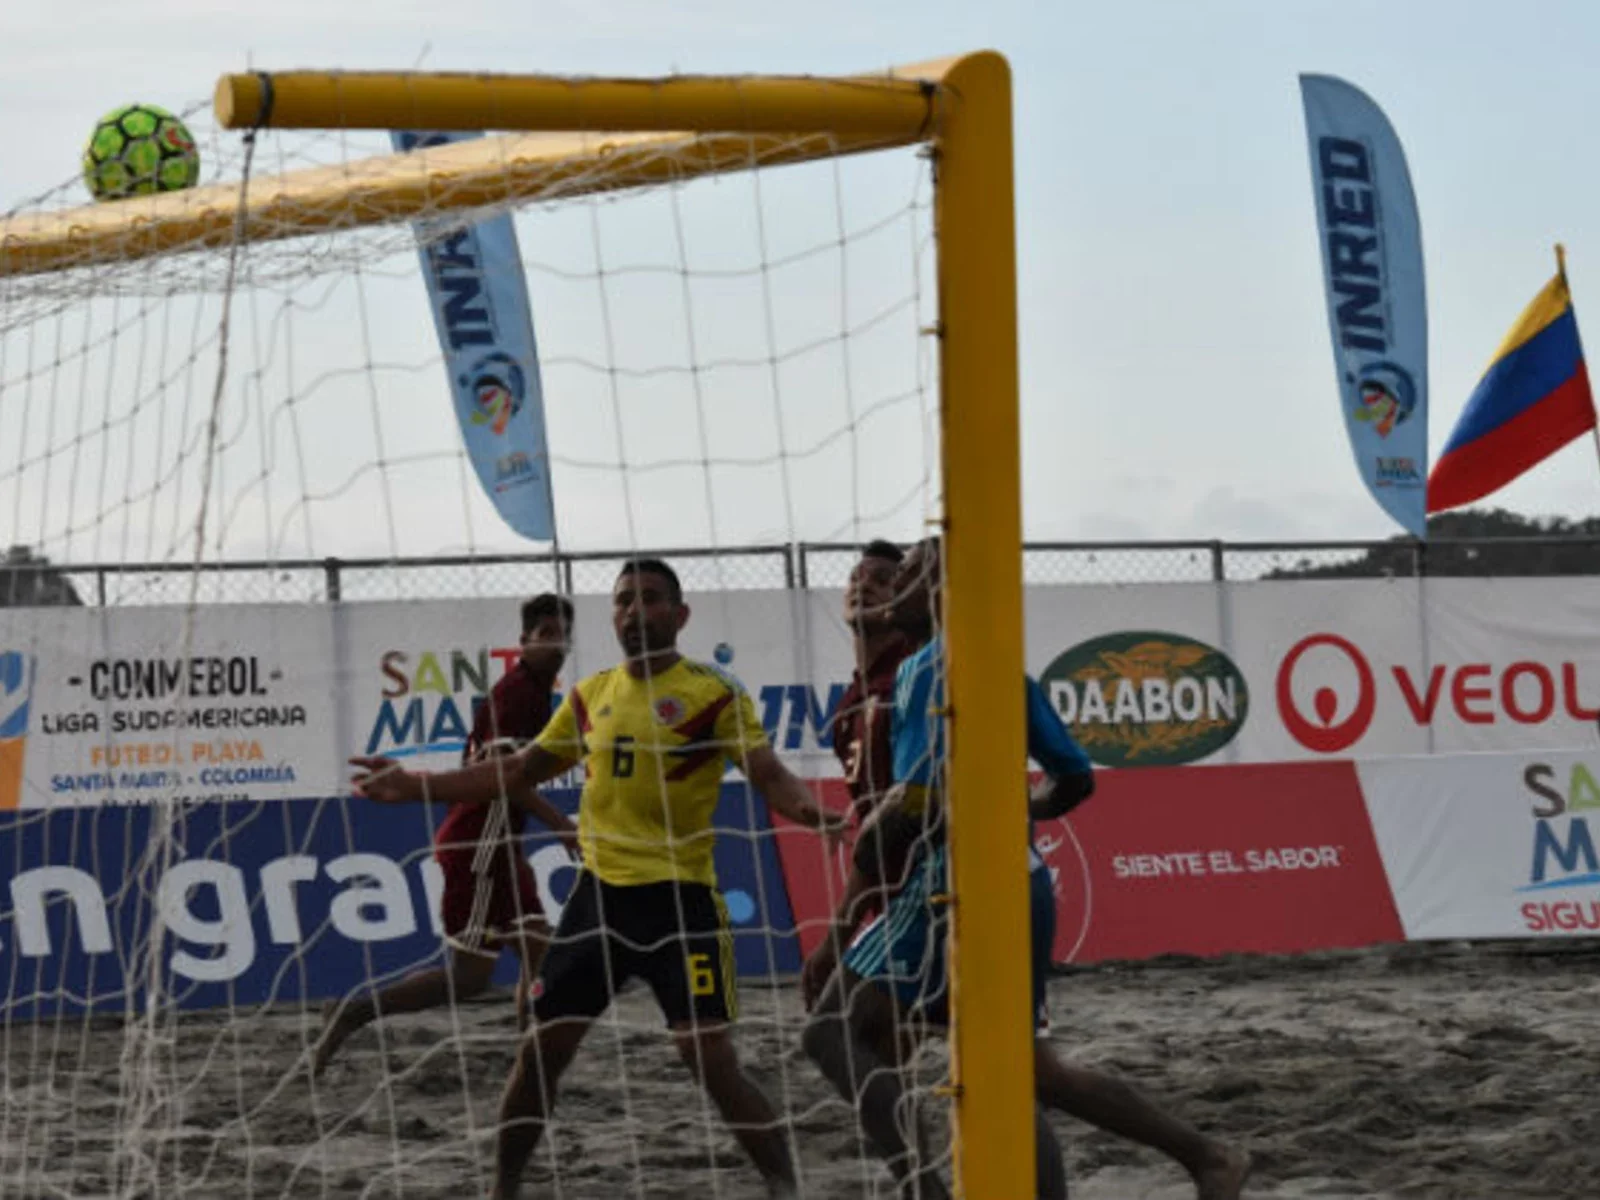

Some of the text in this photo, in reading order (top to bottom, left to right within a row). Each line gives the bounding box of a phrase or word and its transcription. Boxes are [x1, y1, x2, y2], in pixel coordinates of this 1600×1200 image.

[1319, 137, 1387, 353] INRED
[380, 648, 563, 698] SANT
[41, 704, 307, 735] LIGA SUDAMERICANA
[1048, 676, 1237, 725] DAABON
[191, 739, 265, 765] PLAYA
[611, 735, 635, 778] 6
[1112, 846, 1340, 879] SIENTE EL SABOR
[686, 952, 715, 997] 6
